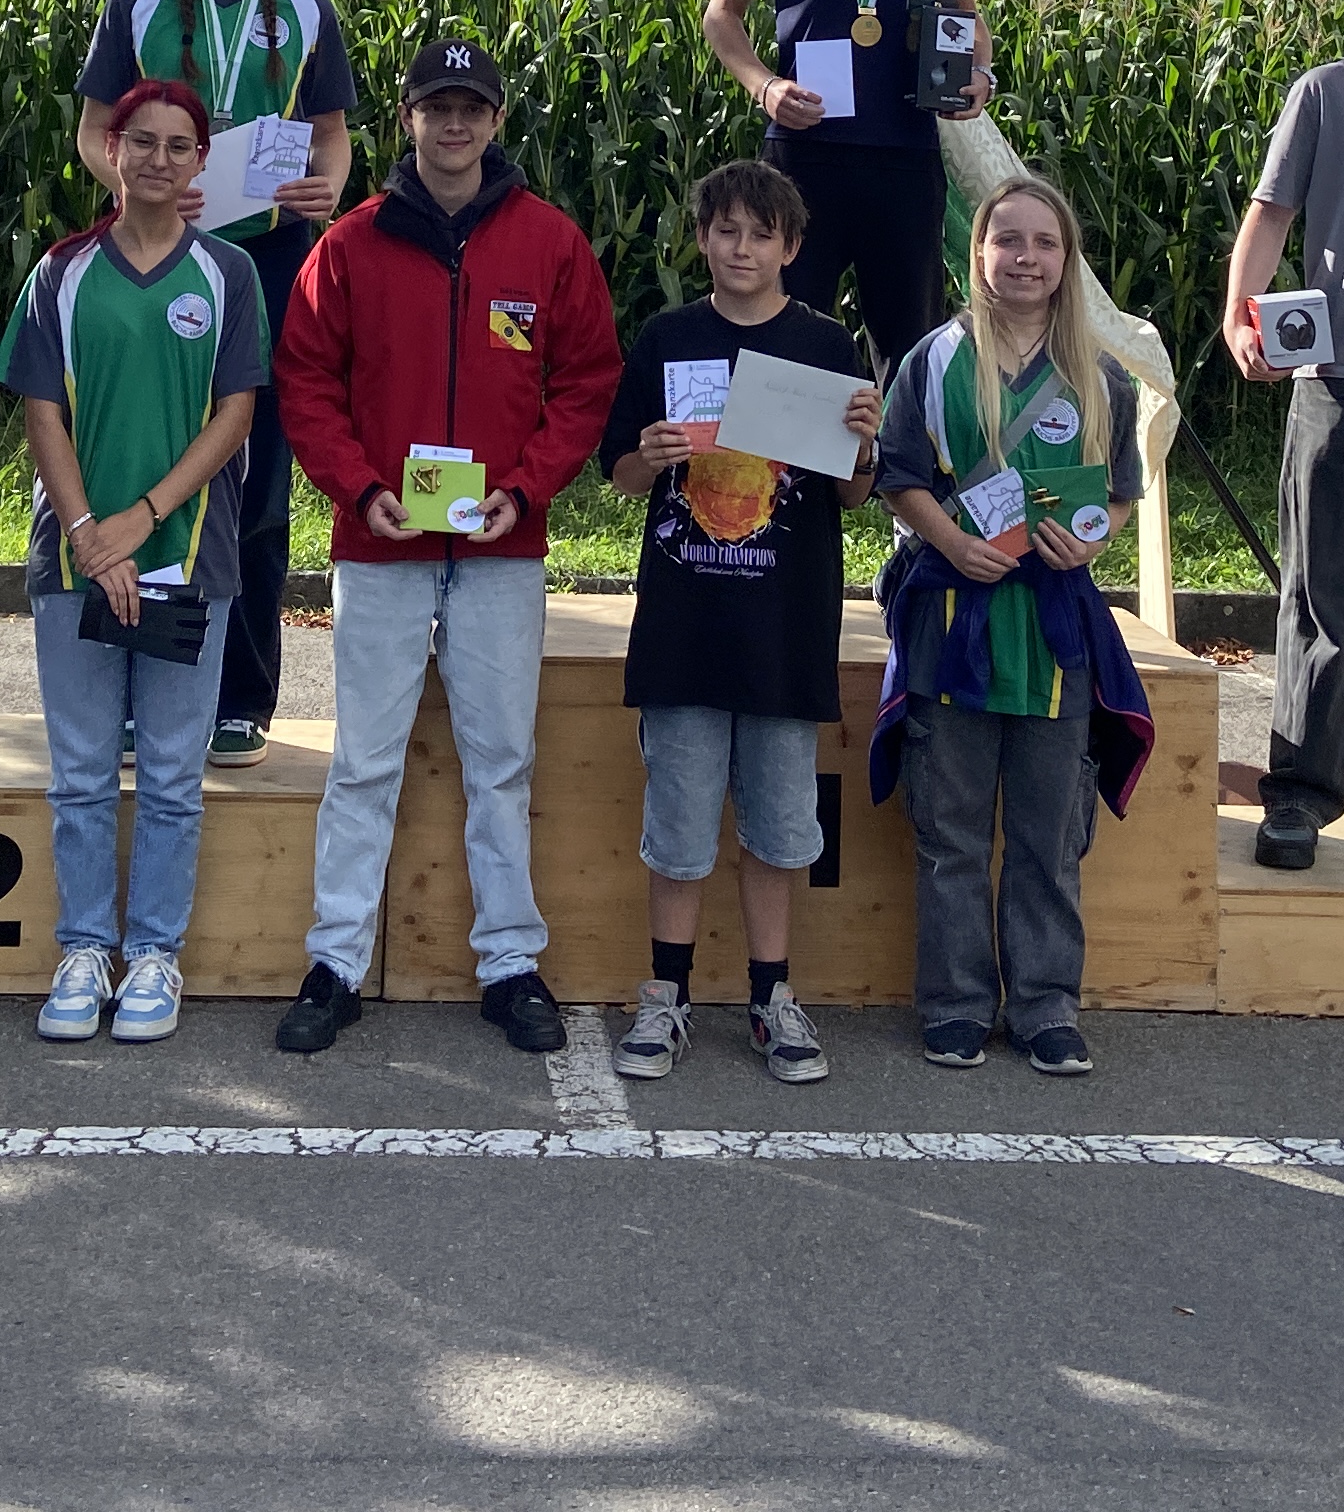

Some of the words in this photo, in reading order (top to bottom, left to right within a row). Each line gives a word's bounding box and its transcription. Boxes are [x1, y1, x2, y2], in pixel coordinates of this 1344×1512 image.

[492, 301, 510, 310] TELL
[667, 367, 677, 418] Kranzkarte
[679, 543, 716, 563] WORLD
[718, 547, 776, 567] CHAMPIONS
